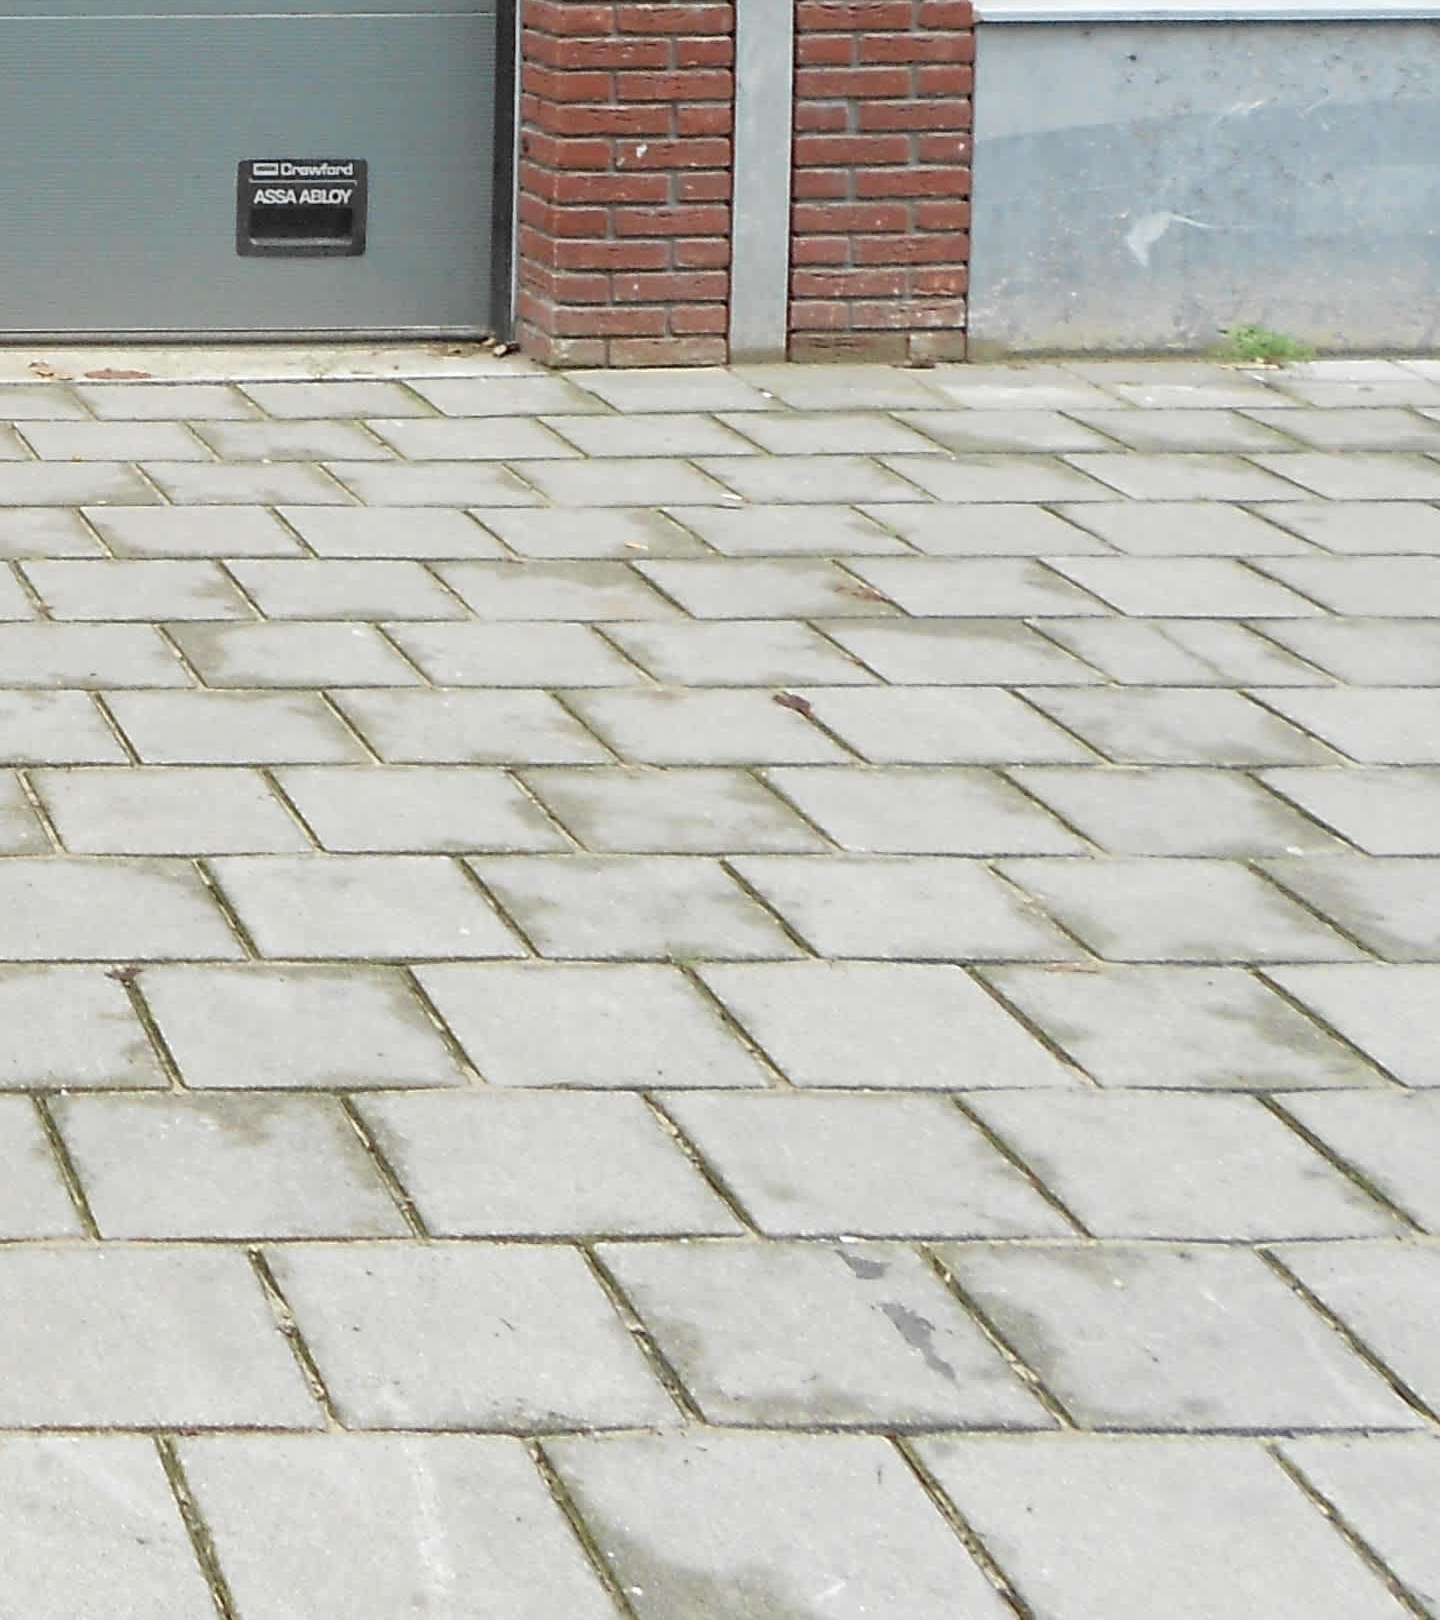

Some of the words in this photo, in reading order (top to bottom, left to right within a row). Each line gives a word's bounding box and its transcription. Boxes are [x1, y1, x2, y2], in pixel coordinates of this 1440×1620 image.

[280, 162, 354, 176] Crawford
[253, 189, 297, 205] ASSA
[299, 188, 353, 205] ABLOY
